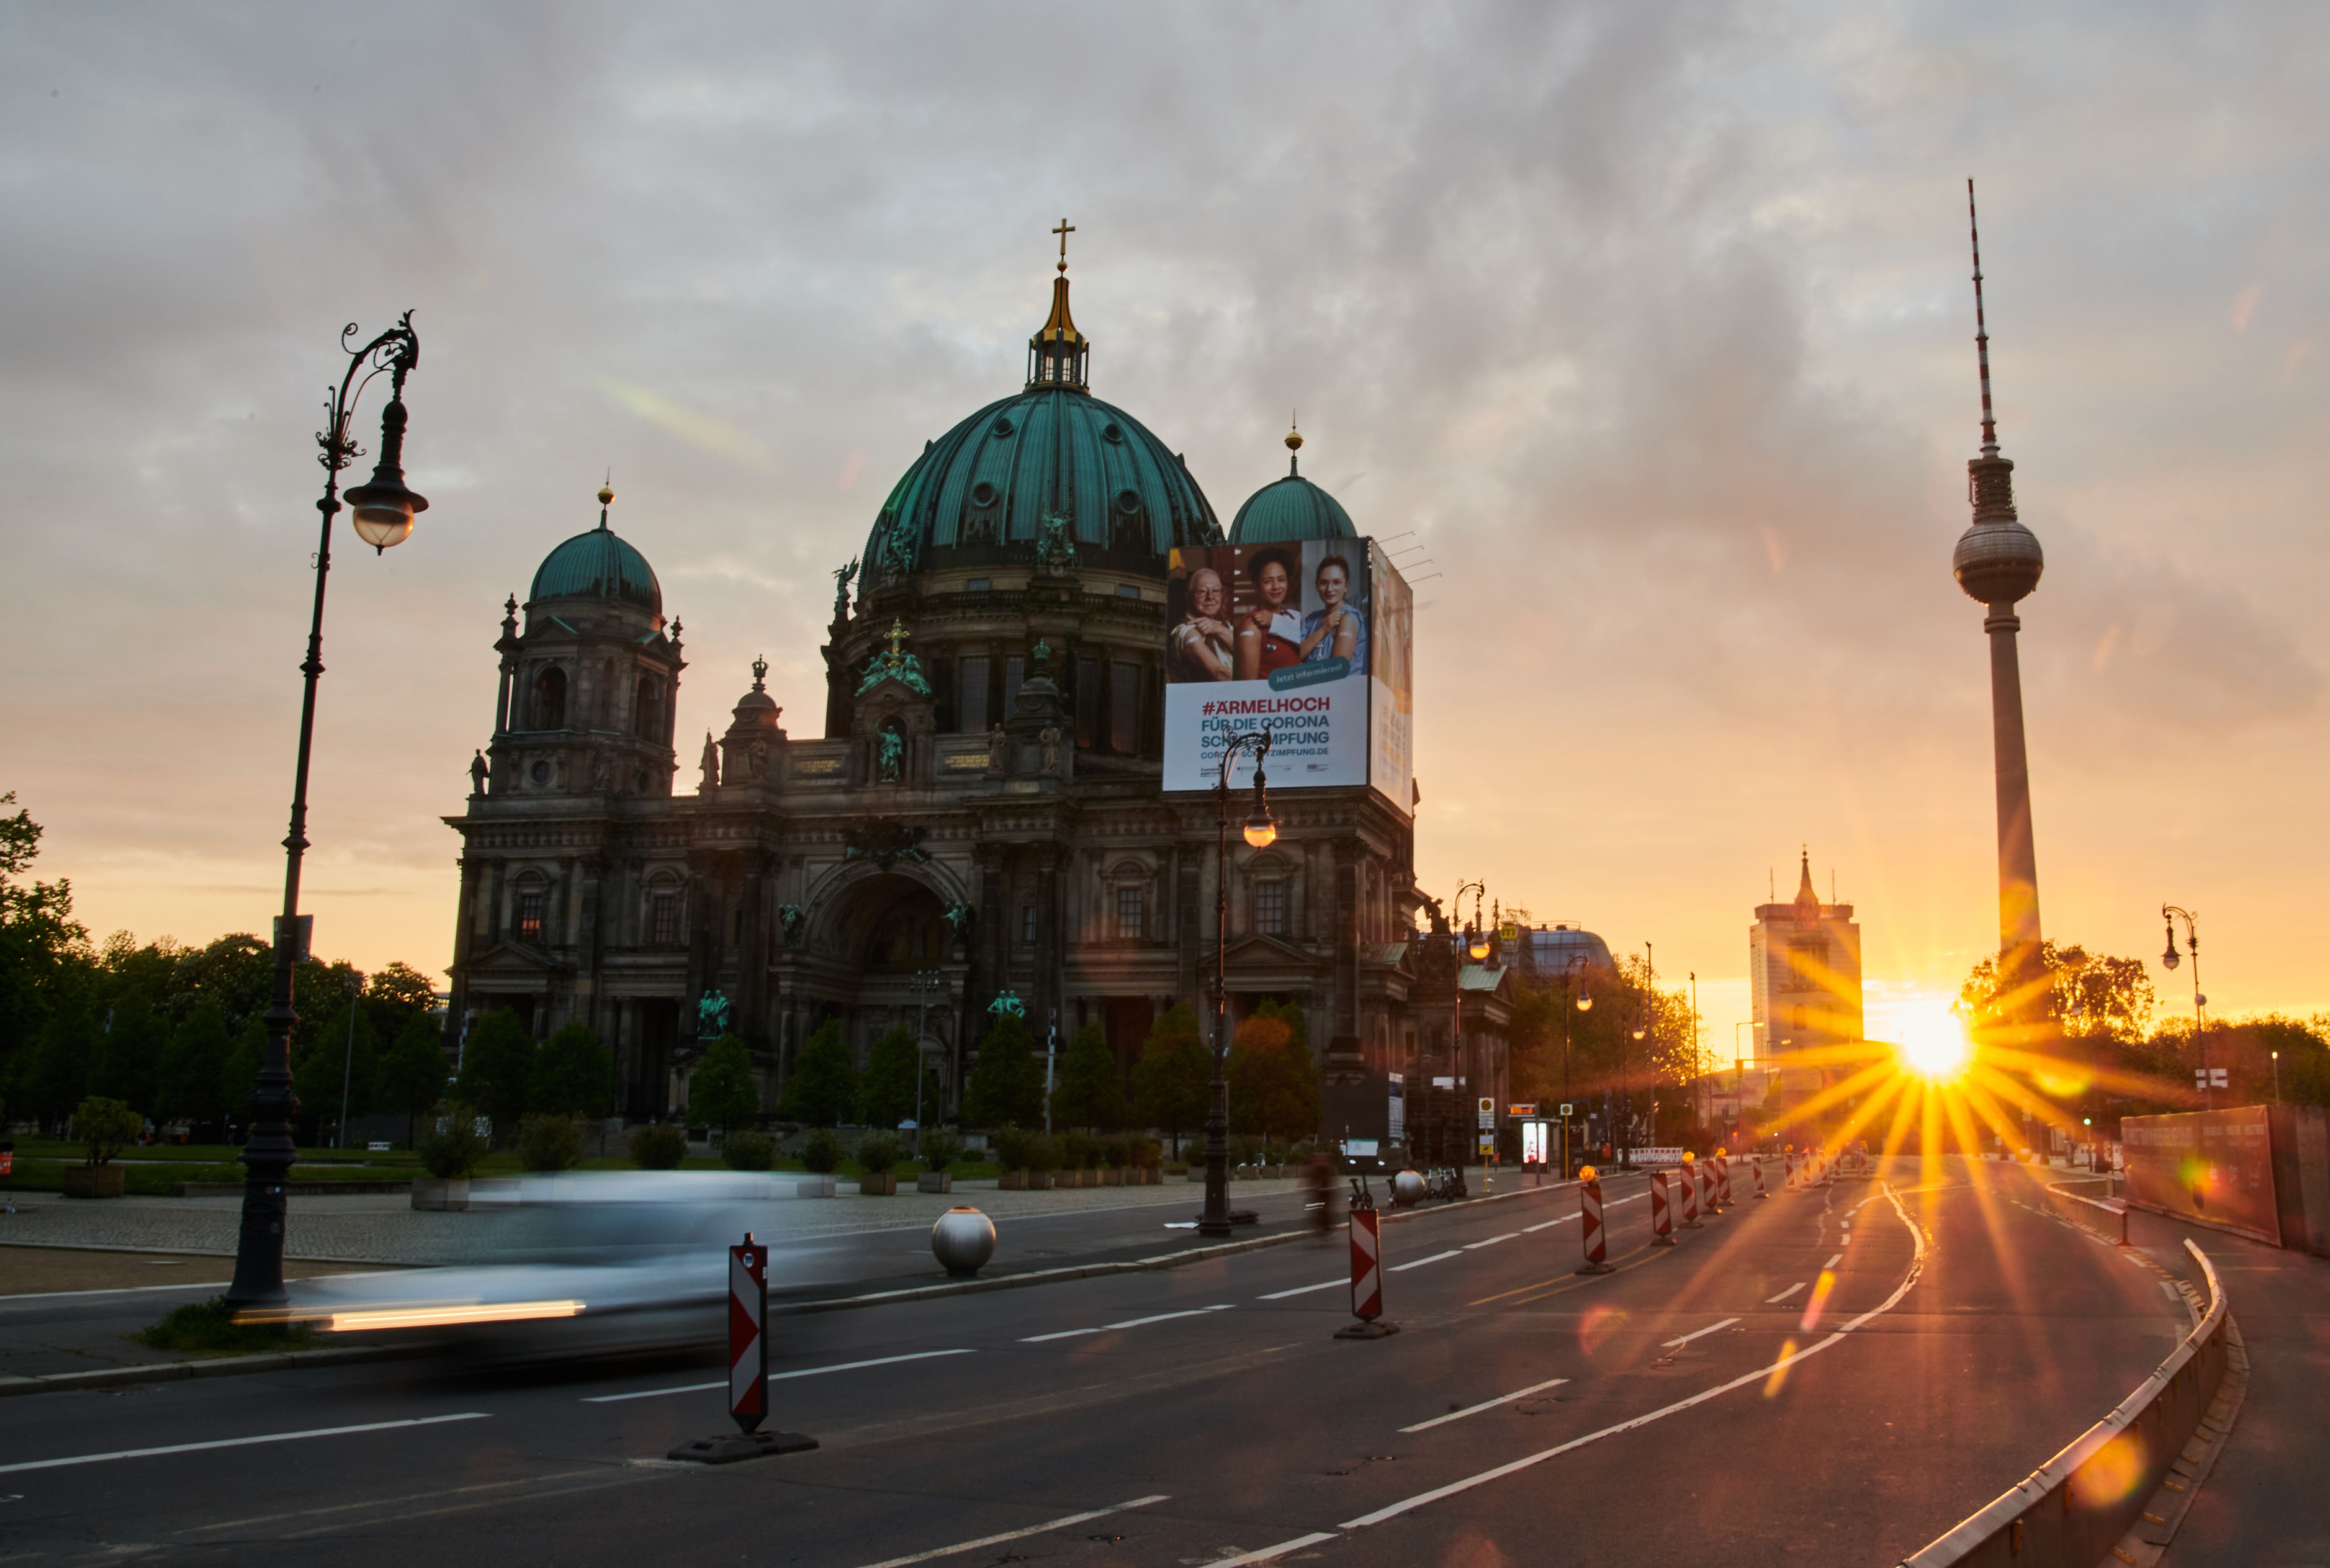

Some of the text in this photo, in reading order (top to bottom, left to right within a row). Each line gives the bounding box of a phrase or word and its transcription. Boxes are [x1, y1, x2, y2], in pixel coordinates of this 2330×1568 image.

[1277, 664, 1342, 683] Jetzt informieren!
[1202, 697, 1330, 715] #ÄRMELHOCH
[1202, 715, 1329, 731] FÜR DIE CORONA
